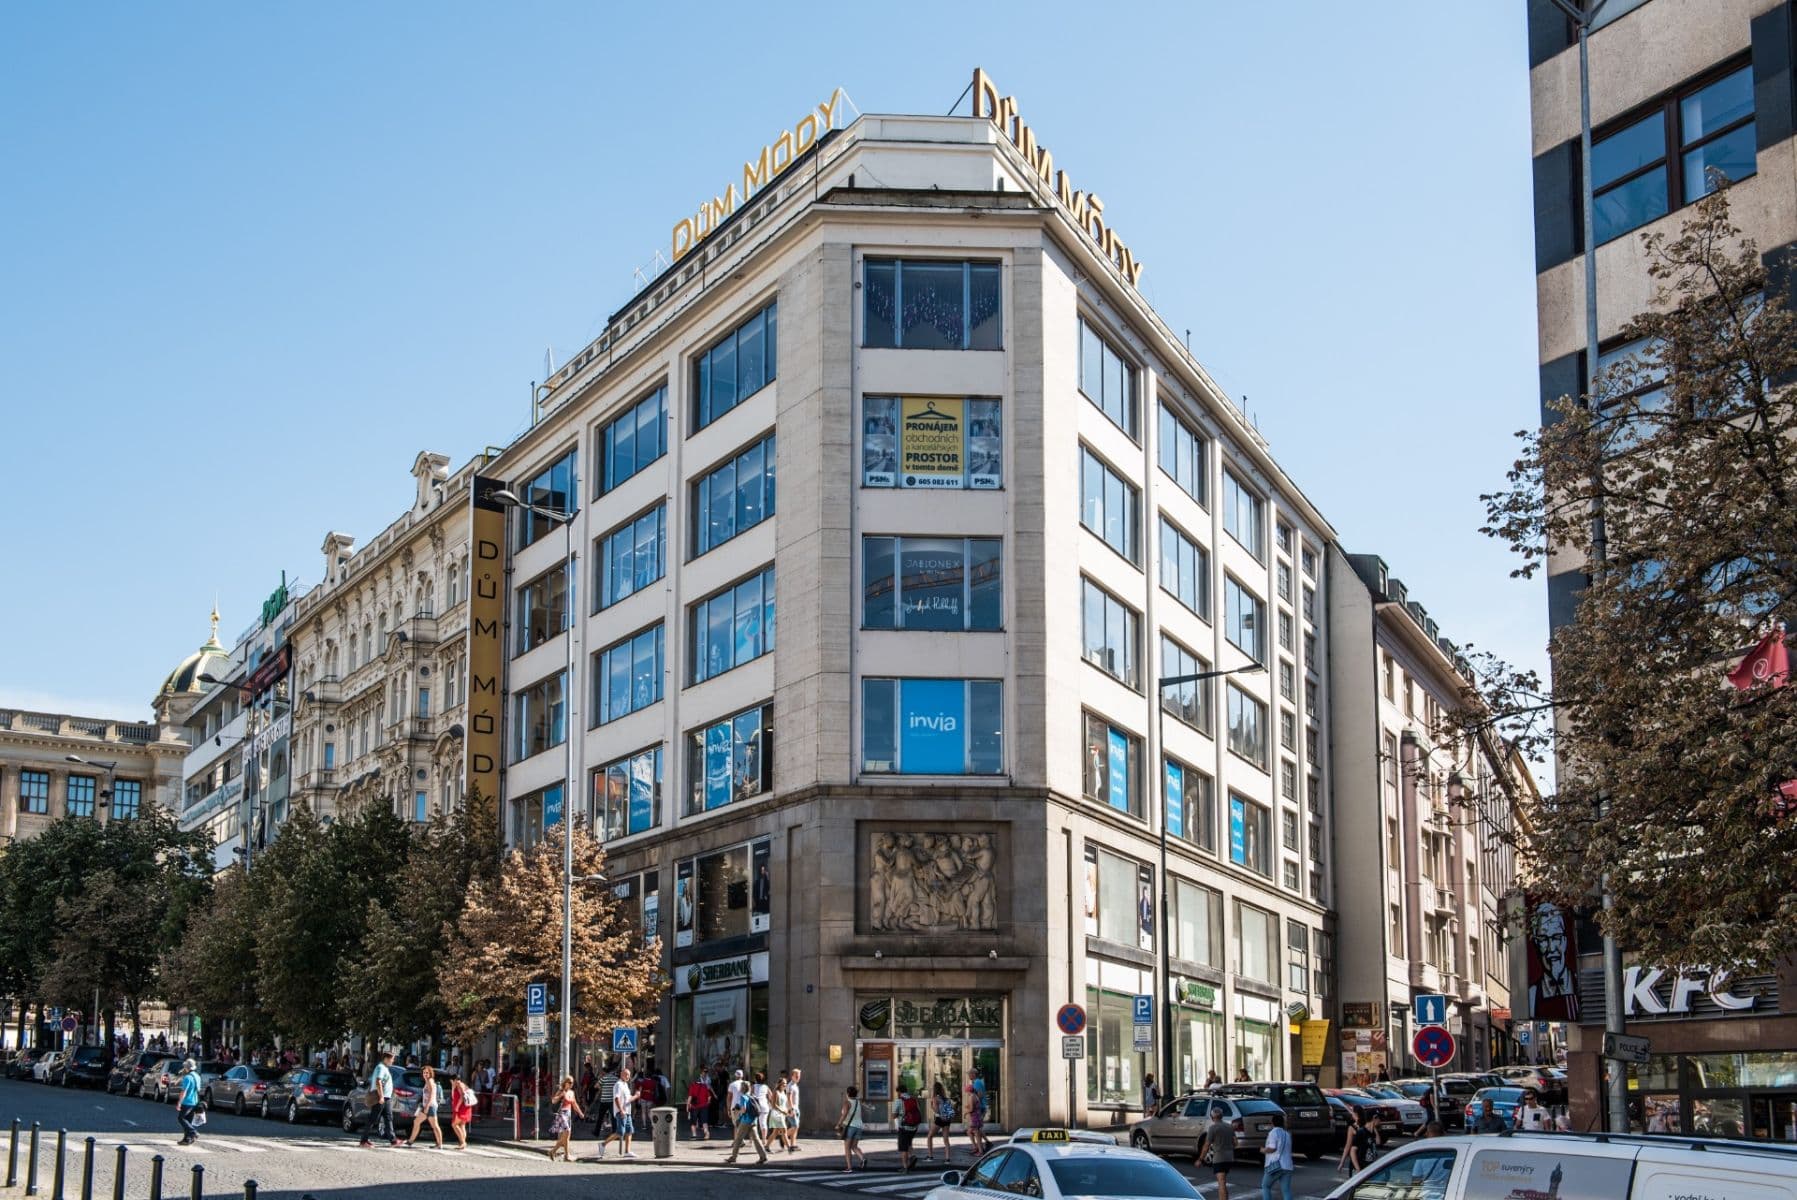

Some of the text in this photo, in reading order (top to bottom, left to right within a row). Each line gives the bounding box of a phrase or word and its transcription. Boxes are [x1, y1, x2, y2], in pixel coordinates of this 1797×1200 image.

[673, 87, 841, 261] DŮM MÓDY
[906, 421, 958, 433] PRONÁJEM
[906, 453, 958, 463] PROSTOR
[473, 540, 498, 803] DŮM MÓD
[910, 711, 956, 732] invia
[703, 959, 752, 981] SBERBANK
[1623, 958, 1757, 1015] KFC
[1041, 1131, 1064, 1139] TAXI
